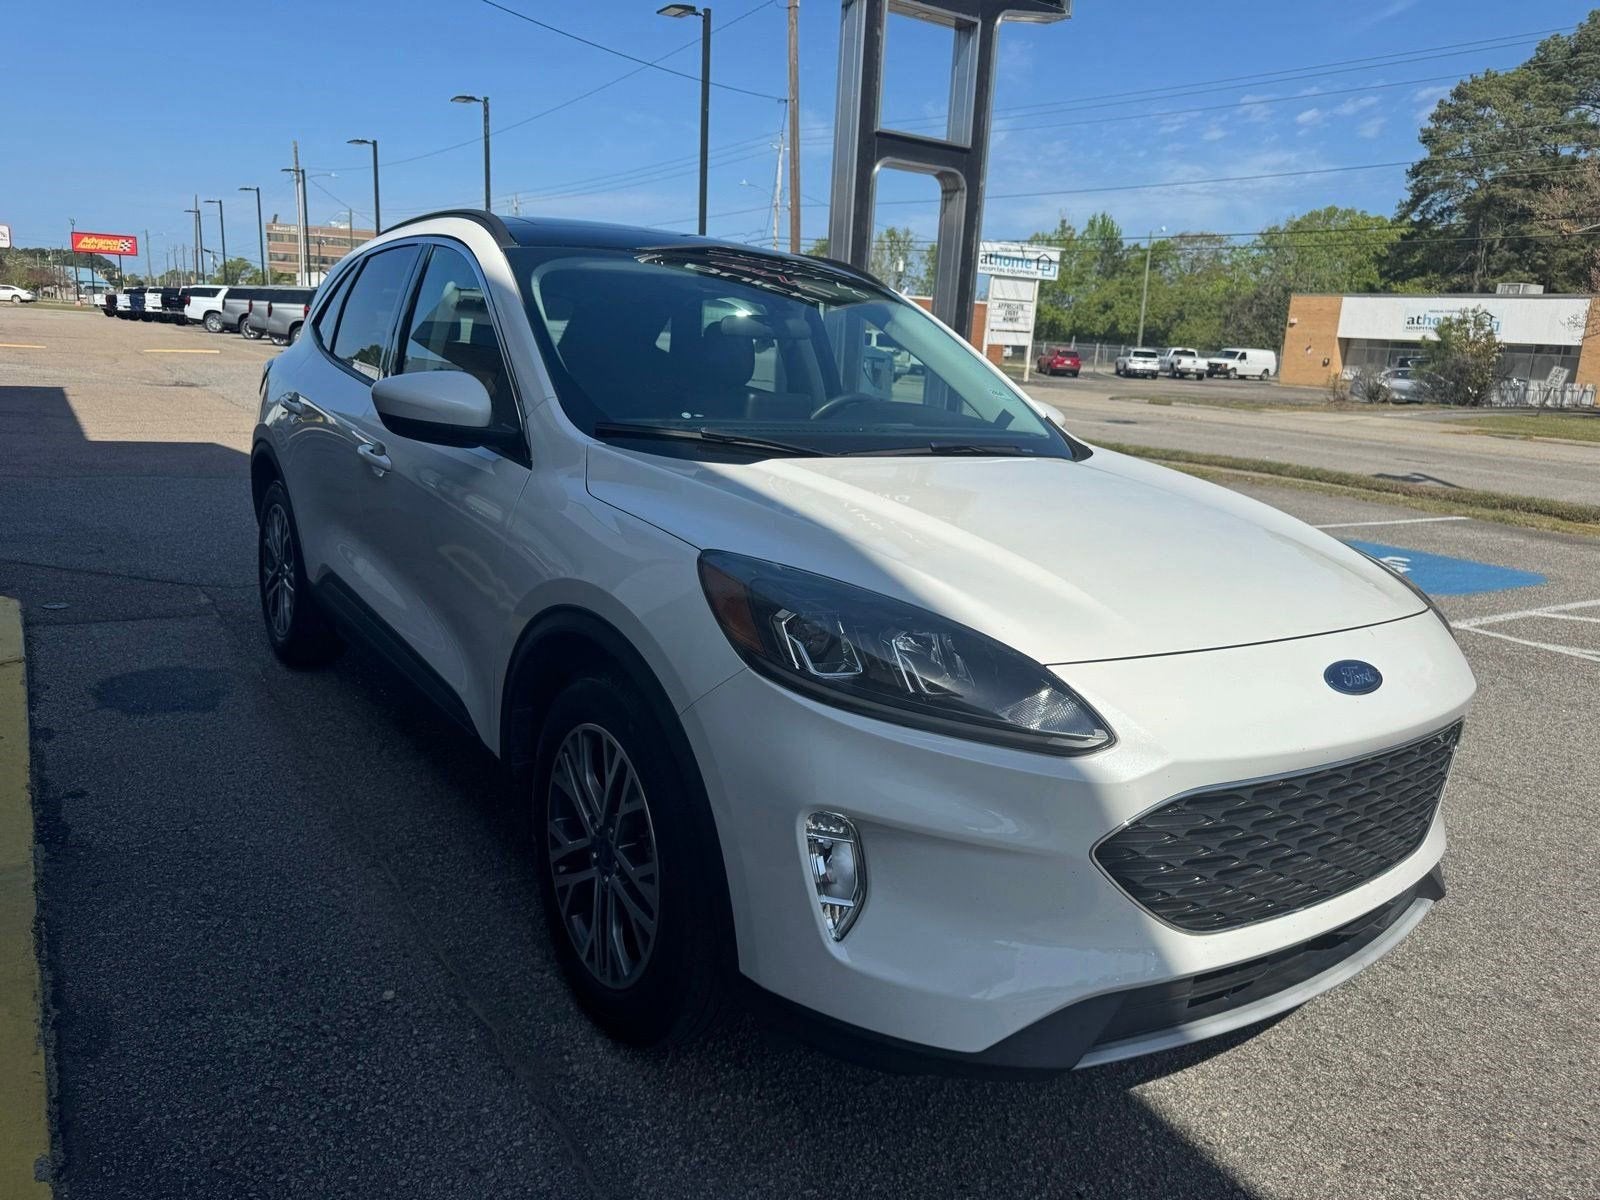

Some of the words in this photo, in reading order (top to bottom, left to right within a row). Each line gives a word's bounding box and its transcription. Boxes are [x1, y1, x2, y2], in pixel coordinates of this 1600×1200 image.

[80, 236, 118, 246] Advance
[980, 252, 1032, 268] athome
[1006, 268, 1038, 276] EQUIPMENT
[1340, 665, 1376, 687] Ford
